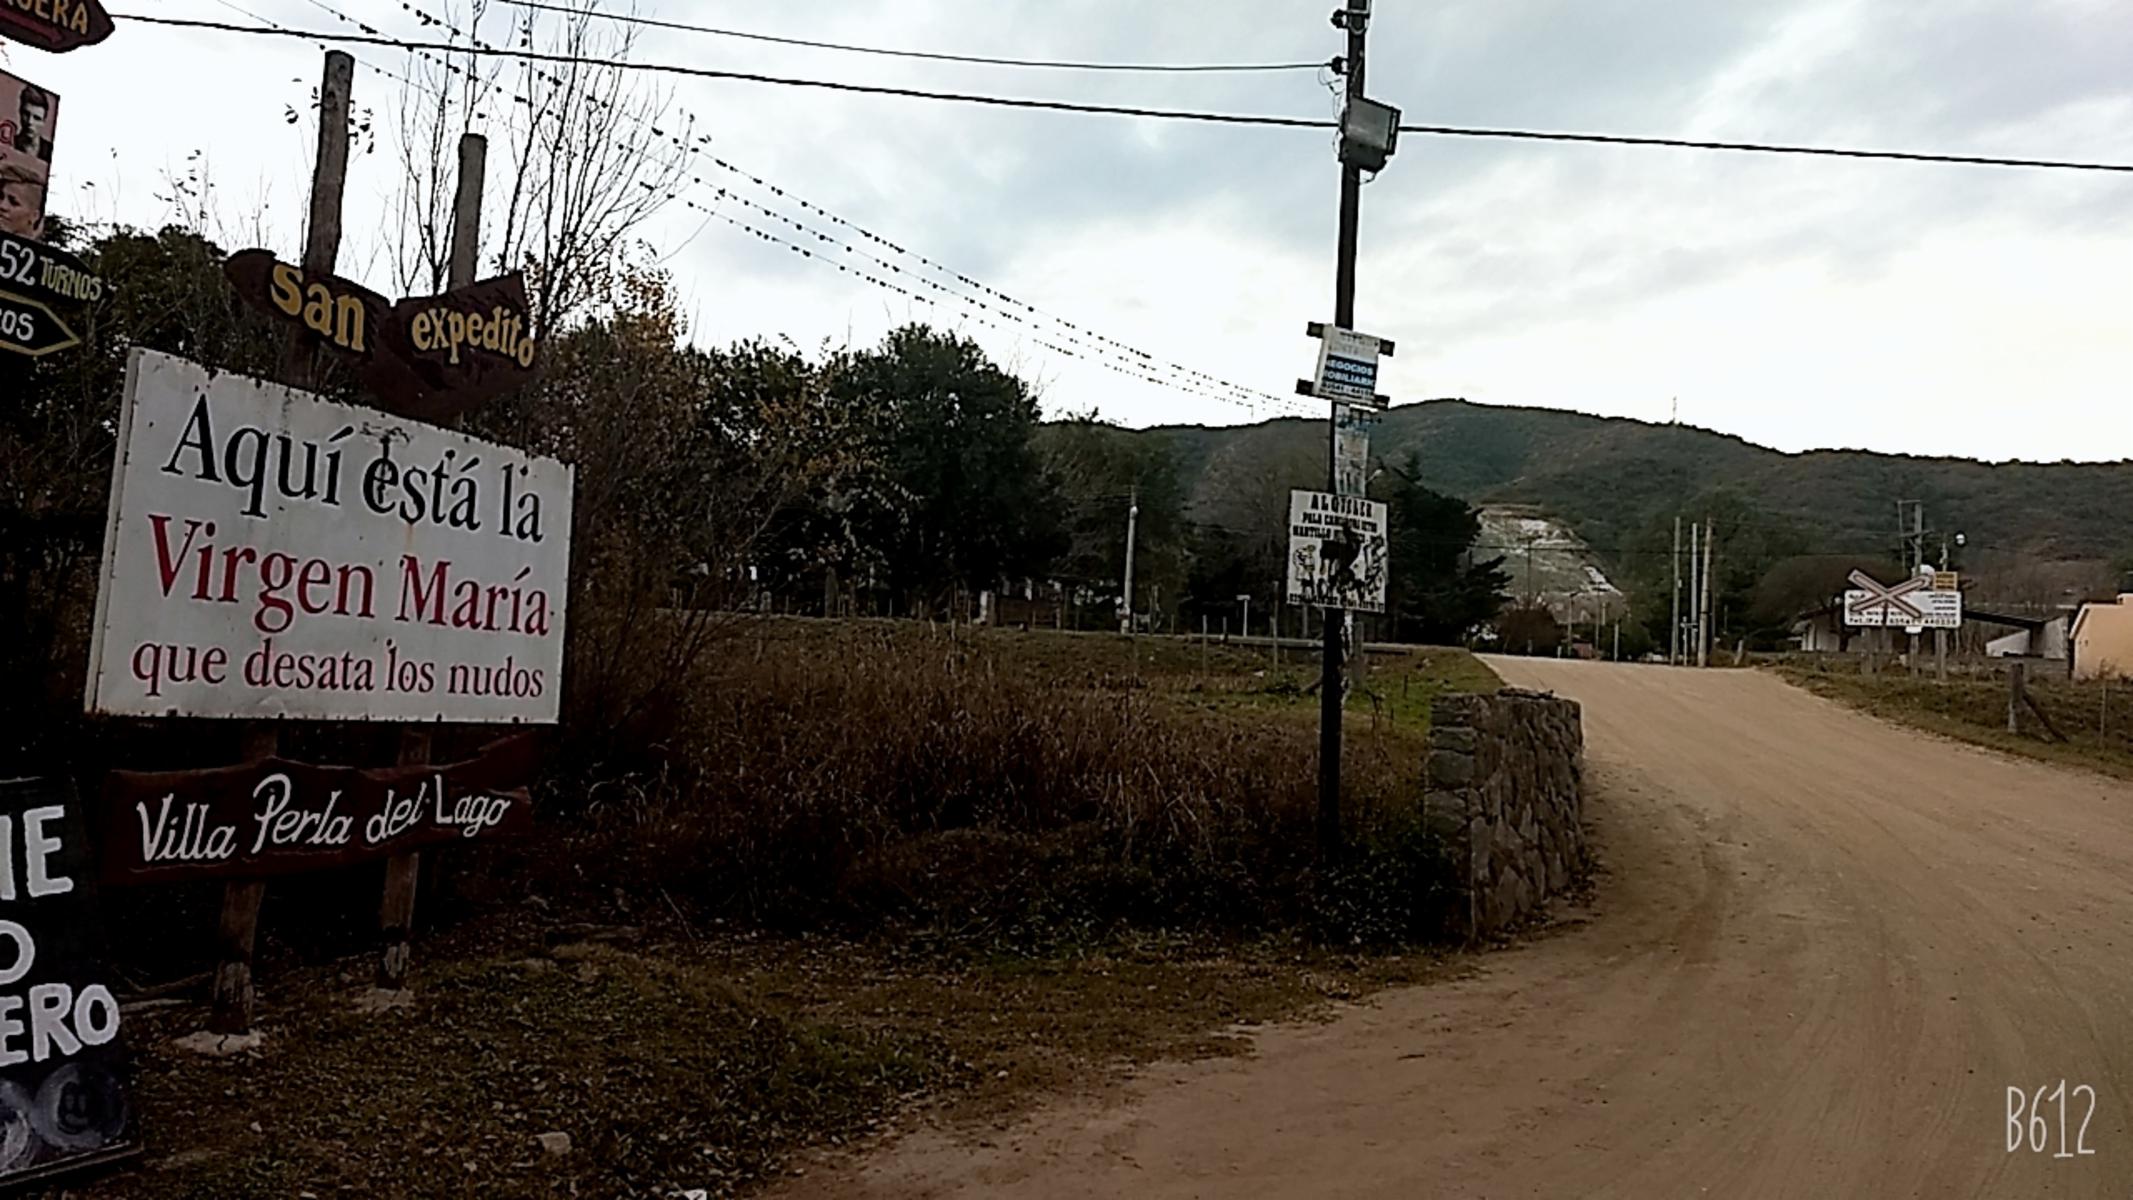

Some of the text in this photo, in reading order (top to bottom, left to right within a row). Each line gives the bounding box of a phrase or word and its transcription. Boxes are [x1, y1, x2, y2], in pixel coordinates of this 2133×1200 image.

[40, 256, 102, 300] TURNOS
[271, 263, 535, 367] San expedito
[0, 307, 34, 341] OS
[162, 393, 543, 543] Aquí está la
[147, 514, 550, 637] Virgen María
[132, 638, 544, 698] que desata los nudos
[136, 772, 511, 862] Villa Perla del Lago
